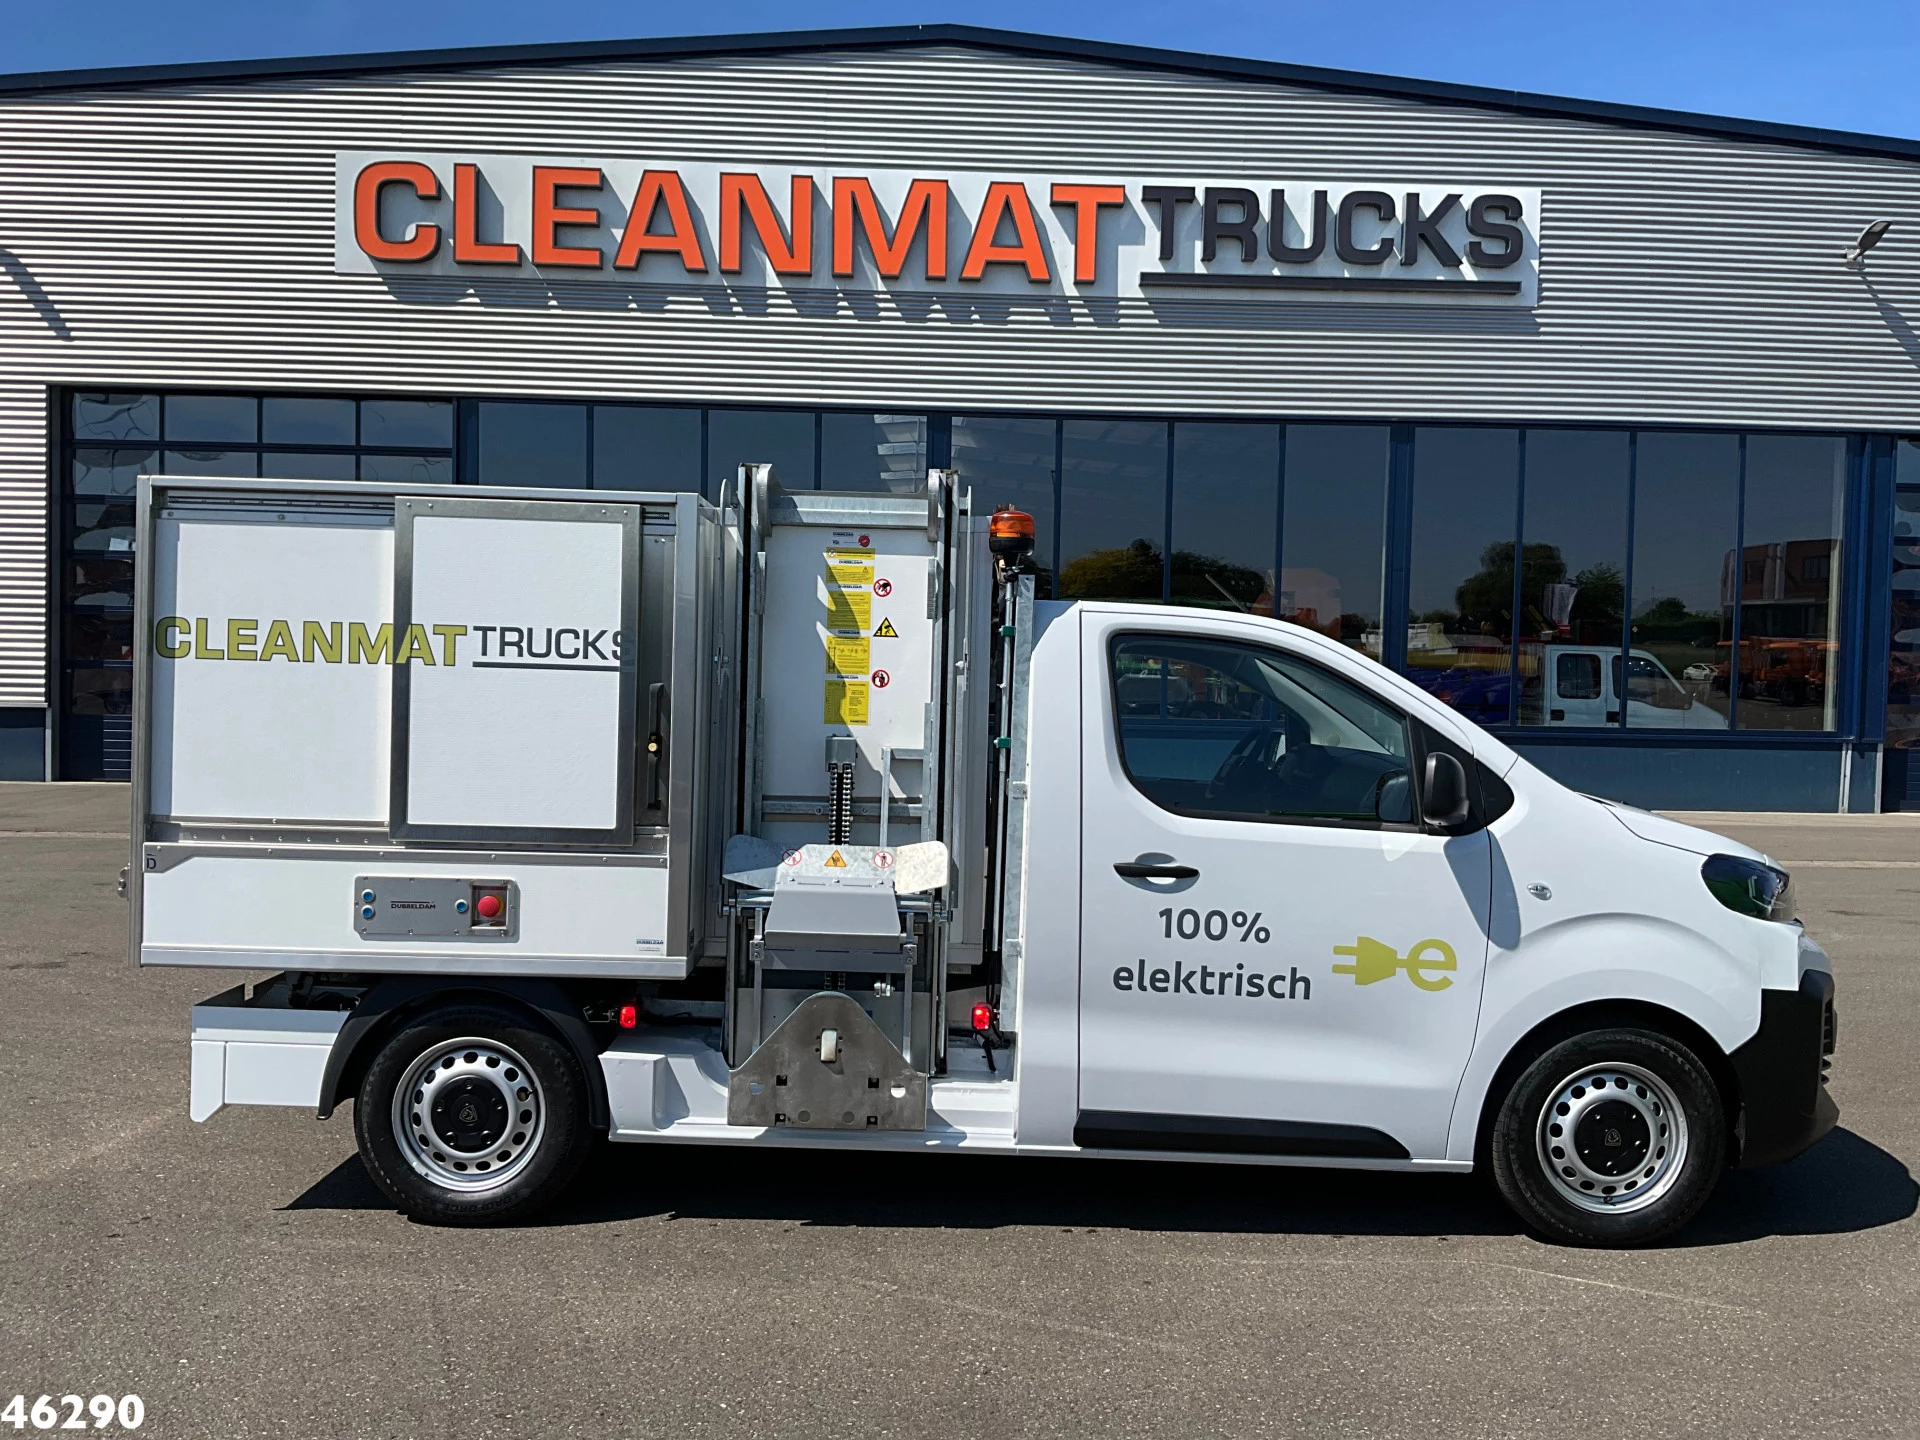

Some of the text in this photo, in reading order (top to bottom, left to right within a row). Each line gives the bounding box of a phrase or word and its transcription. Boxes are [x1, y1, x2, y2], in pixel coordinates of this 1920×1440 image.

[353, 160, 1524, 285] CLEANMAT TRUCKS
[155, 615, 468, 667] CLEANMAT
[390, 902, 436, 910] DUBBELDAM
[1158, 907, 1271, 944] 100%
[1112, 958, 1312, 1001] elektrisch
